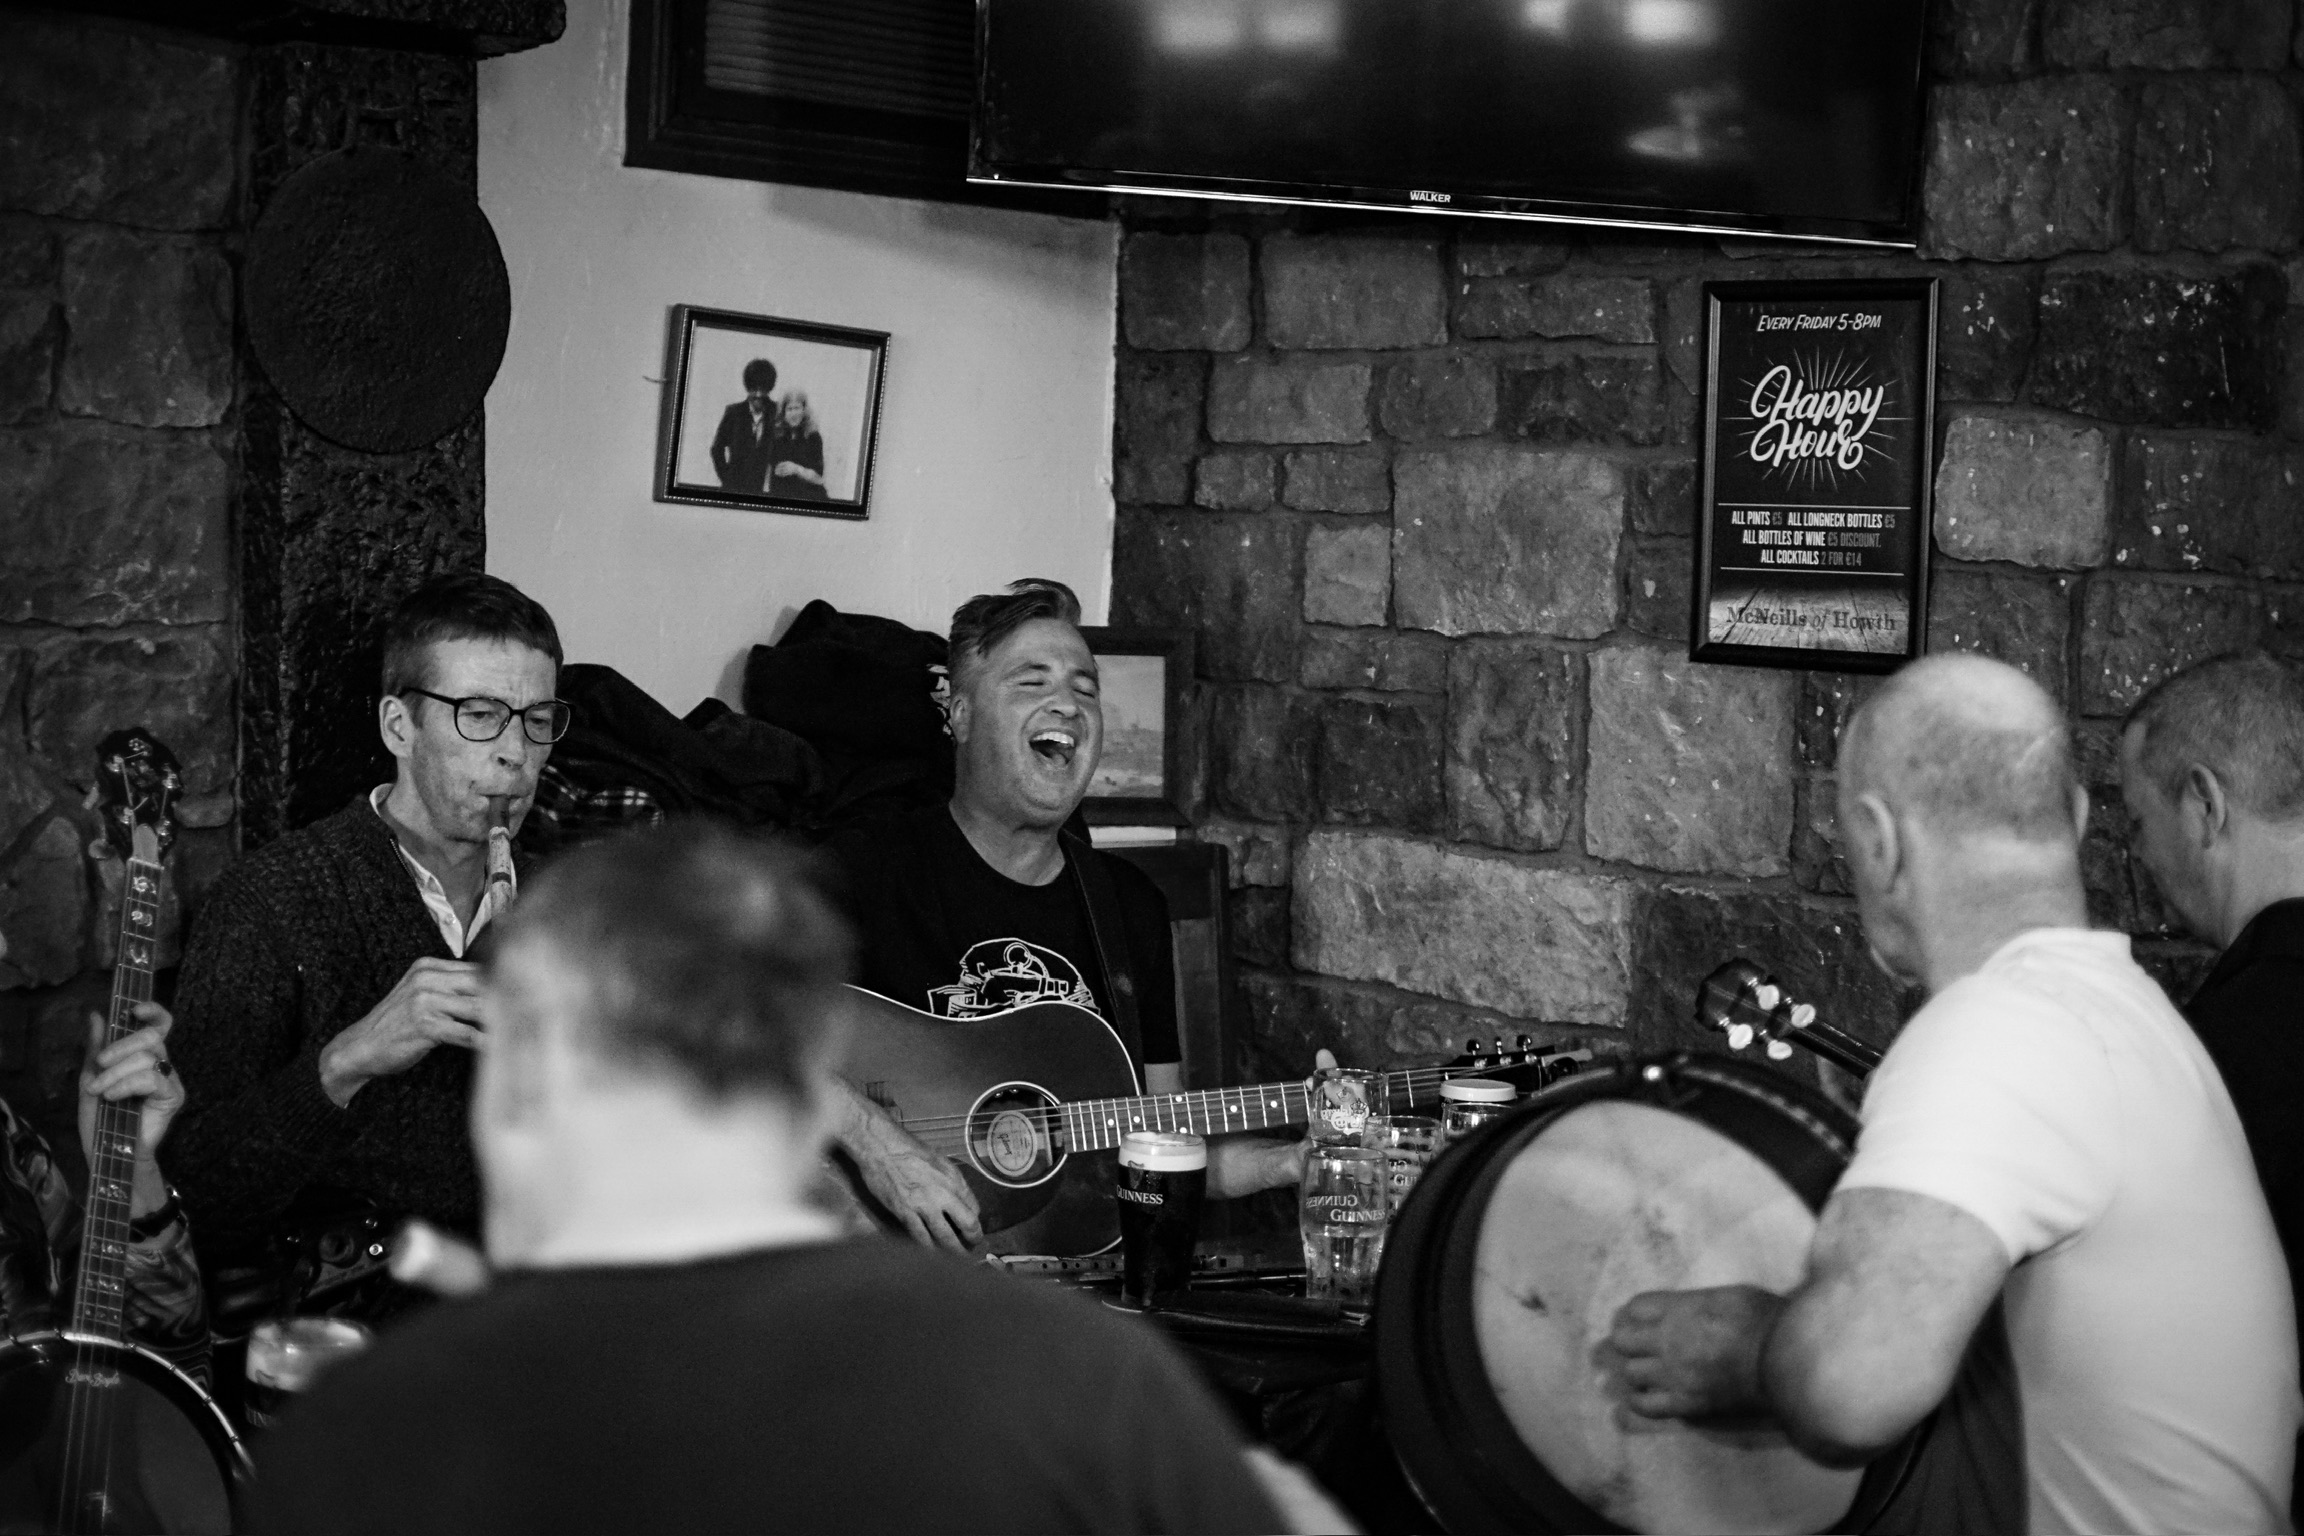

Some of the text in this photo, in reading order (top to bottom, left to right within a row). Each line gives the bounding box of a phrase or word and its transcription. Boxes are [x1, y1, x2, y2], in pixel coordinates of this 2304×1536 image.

[1410, 191, 1451, 202] WALKER
[1757, 313, 1883, 332] EVERY FRIDAY 5-8PM
[1751, 365, 1884, 441] Happy
[1751, 419, 1864, 471] Hour
[1731, 511, 1745, 525] ALL
[1747, 511, 1770, 526] PINTS
[1787, 511, 1802, 526] ALL
[1803, 512, 1845, 527] LONGNECK
[1847, 513, 1883, 528] BOTTLES
[1742, 530, 1757, 545] ALL
[1758, 530, 1793, 545] BOTTLES
[1794, 531, 1805, 546] OF
[1805, 531, 1826, 546] WINE
[1760, 549, 1862, 566] ALL COCKTAILS 2 FOR €14
[1726, 606, 1897, 631] McNeills of Howth
[1116, 1184, 1164, 1205] GUINNESS
[1330, 1208, 1386, 1223] GUINNESS
